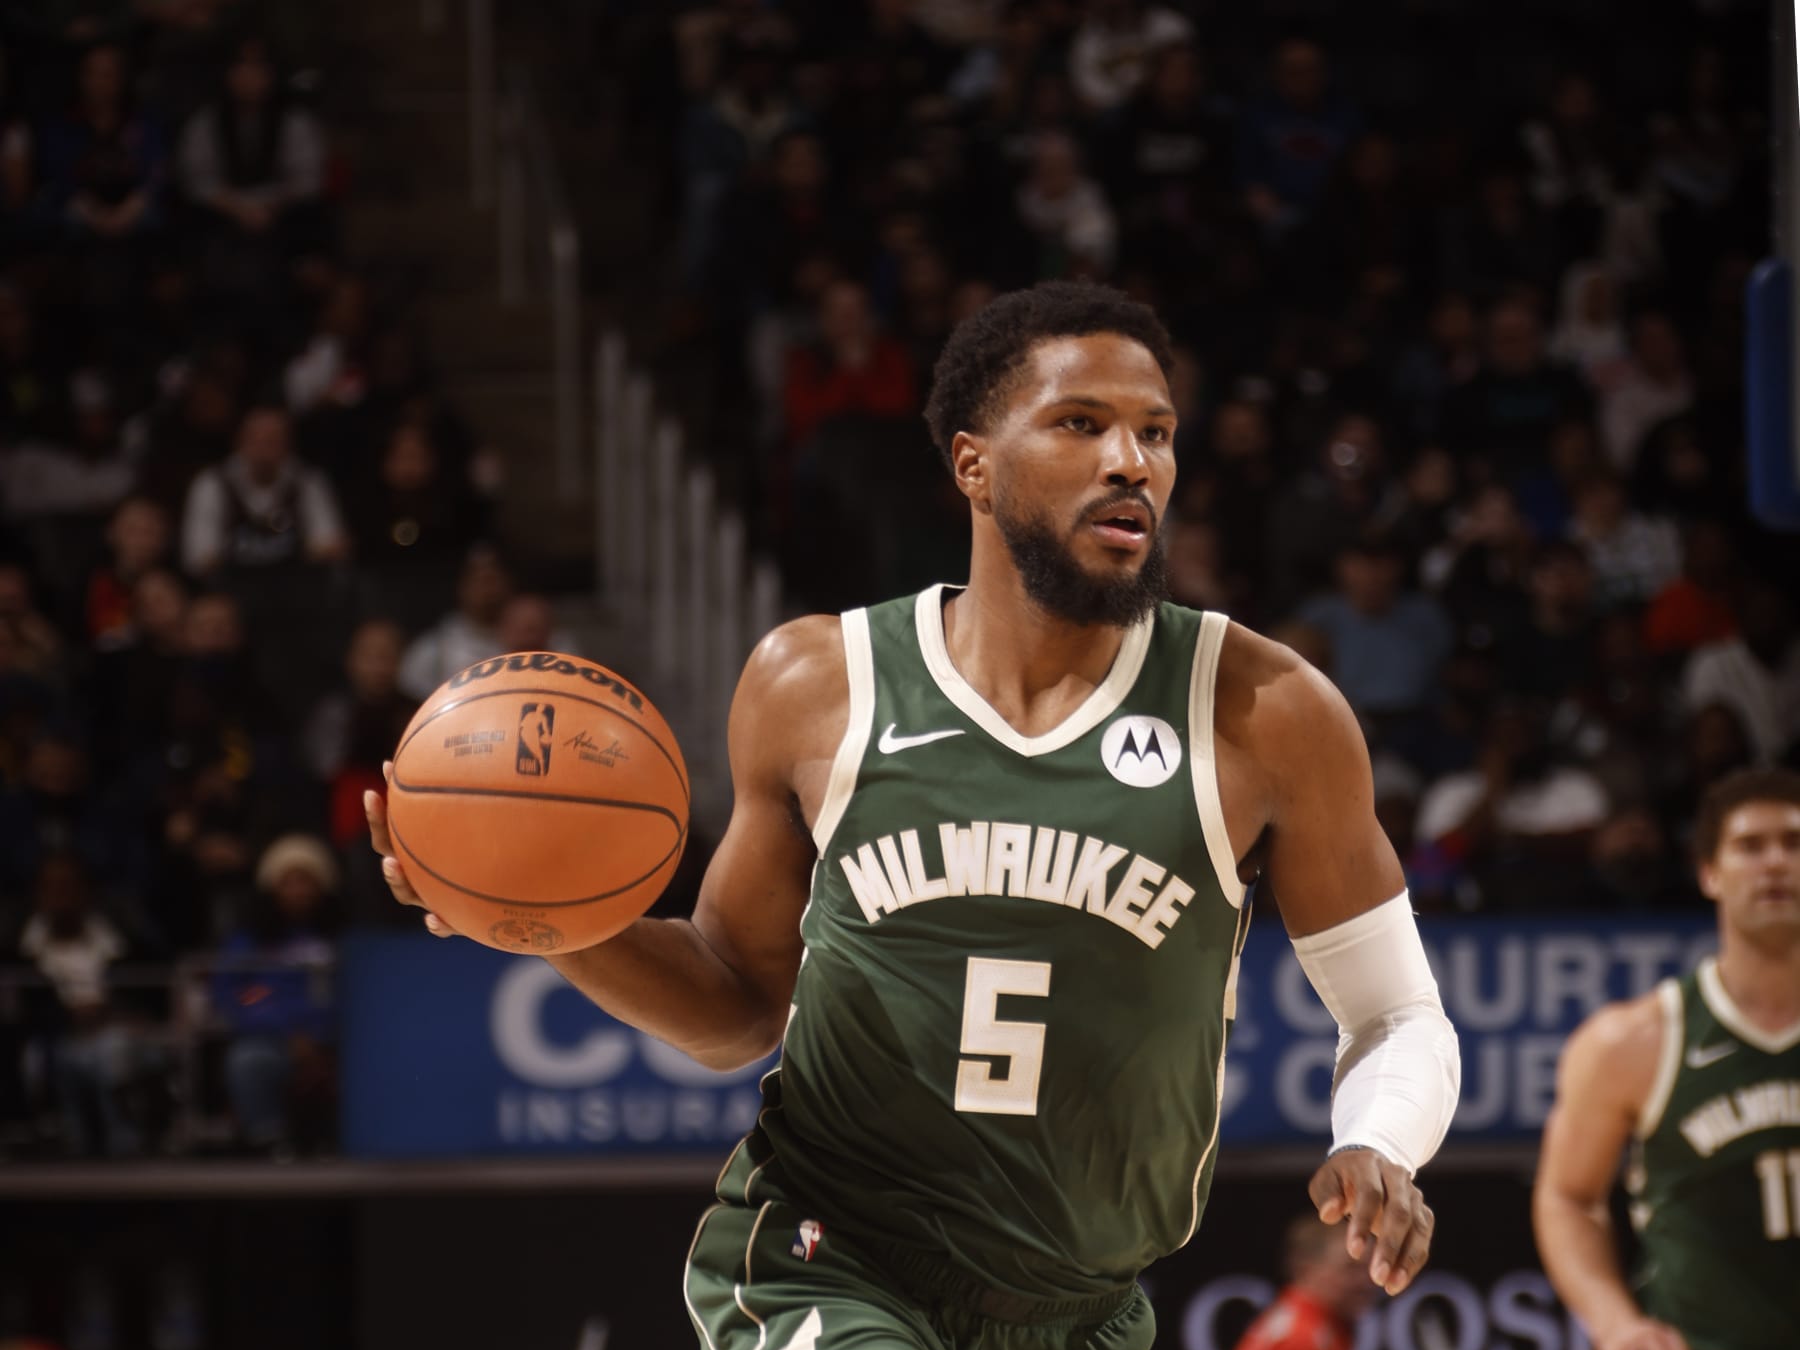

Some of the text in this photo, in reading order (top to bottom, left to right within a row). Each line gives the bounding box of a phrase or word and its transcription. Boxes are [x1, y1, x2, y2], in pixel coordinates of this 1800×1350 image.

[449, 653, 642, 714] Wilson
[839, 821, 1196, 950] MILWAUKEE
[954, 957, 1051, 1116] 5
